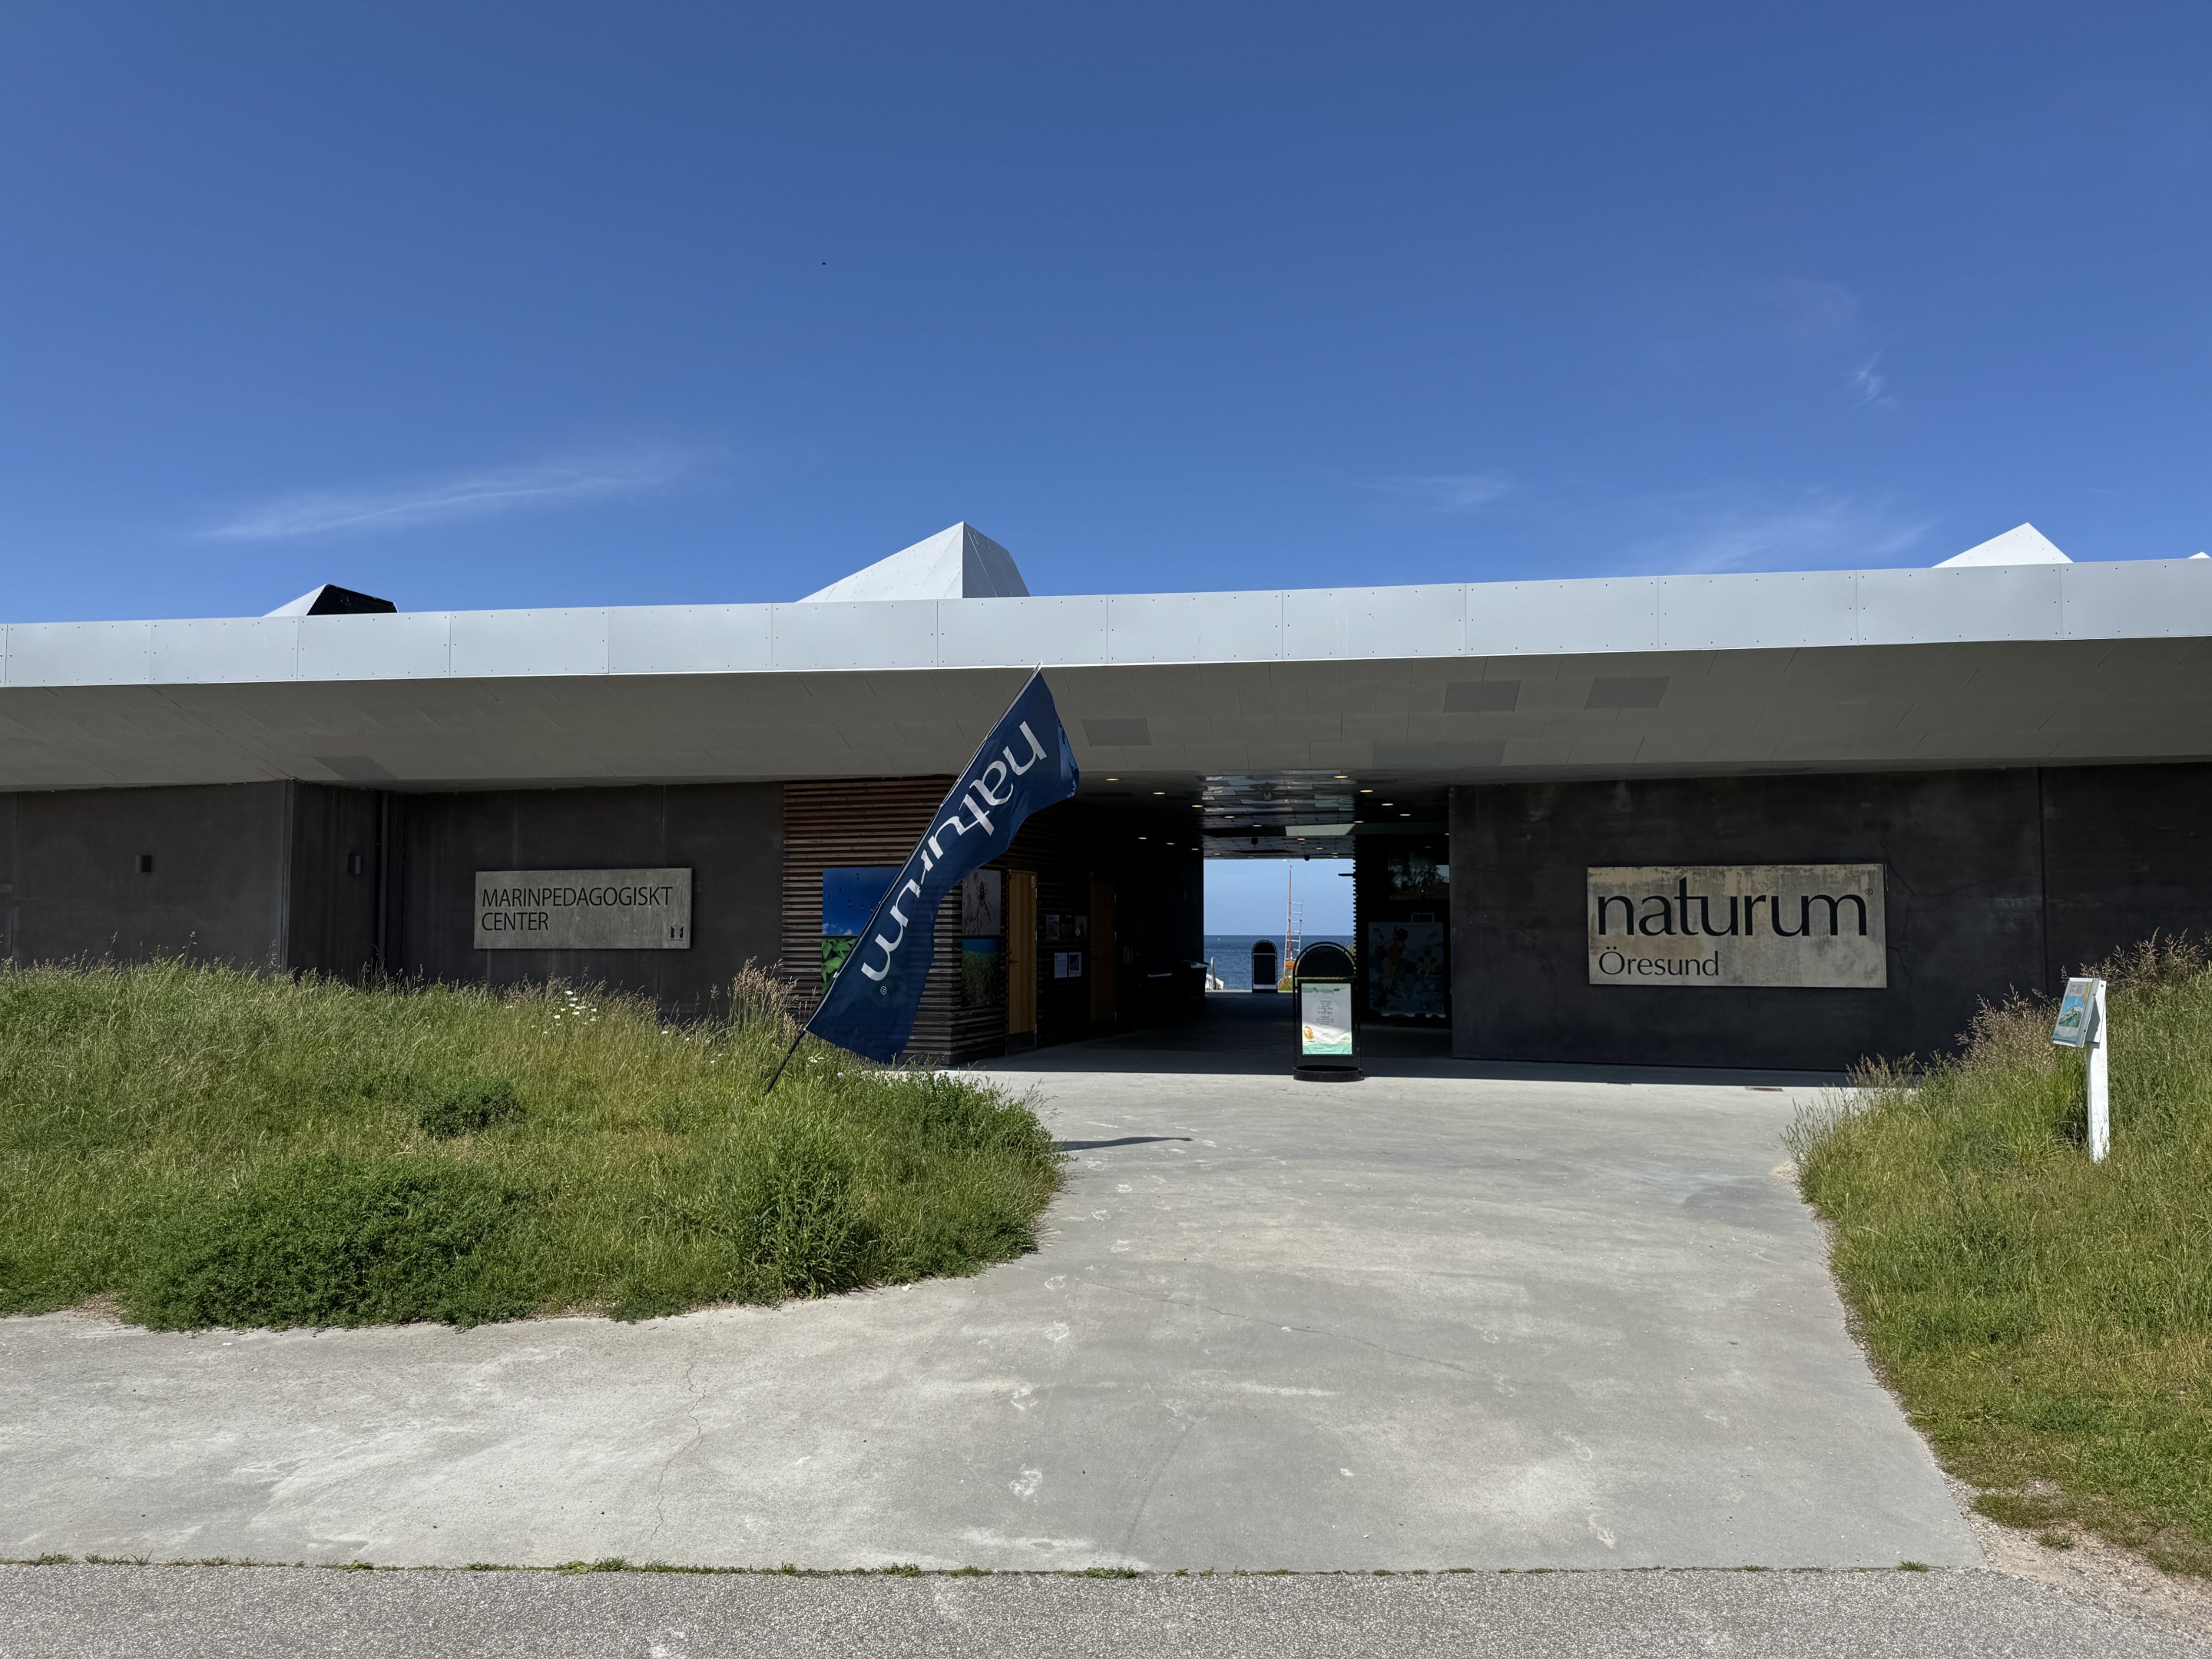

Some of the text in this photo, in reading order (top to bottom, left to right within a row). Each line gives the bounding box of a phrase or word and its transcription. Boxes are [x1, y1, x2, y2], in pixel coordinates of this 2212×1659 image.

[482, 886, 672, 907] MARINPEDAGOGISKT
[482, 912, 548, 931] CENTER
[1598, 945, 1720, 976] Öresund
